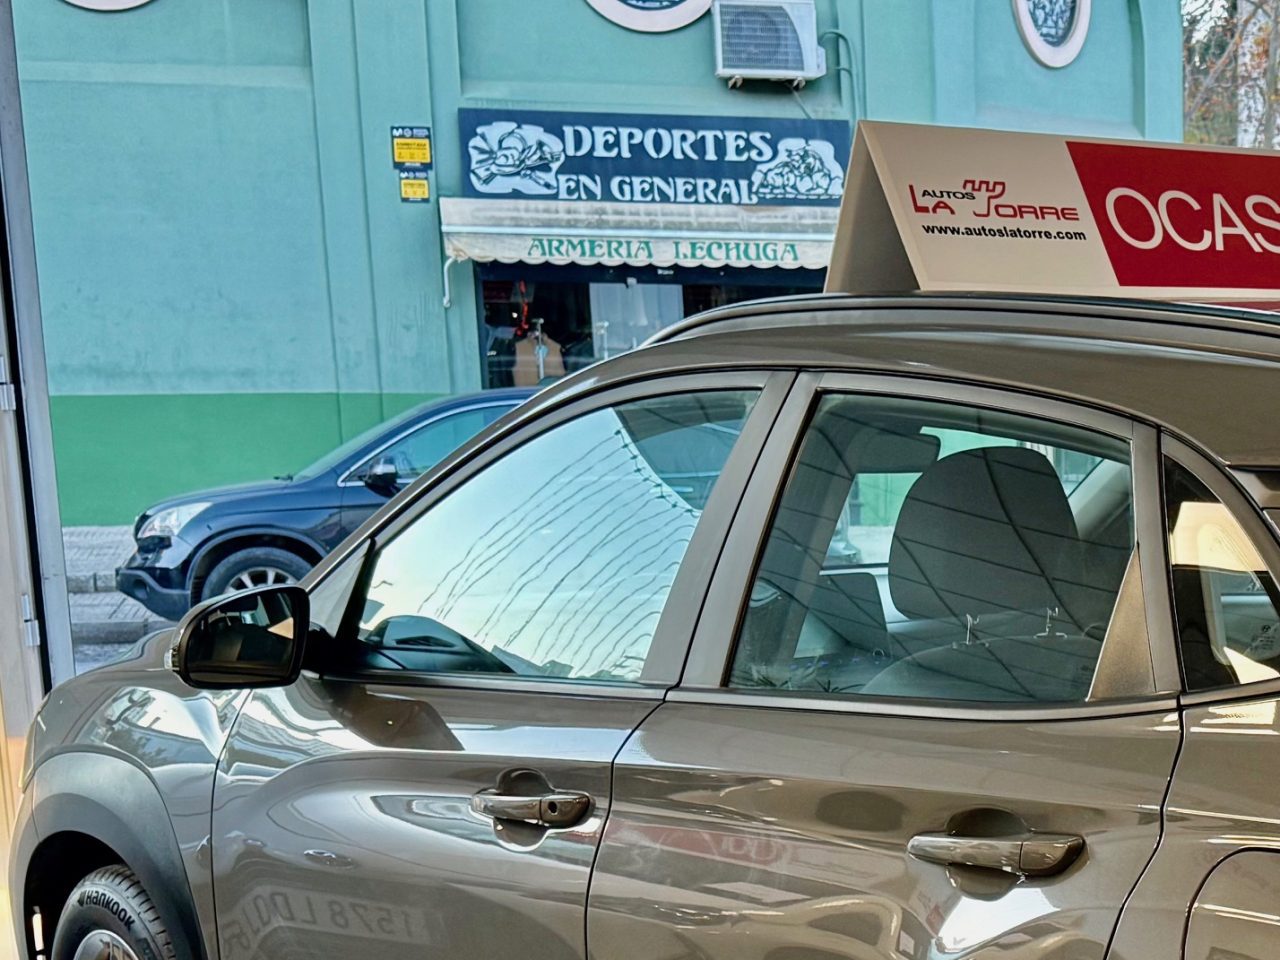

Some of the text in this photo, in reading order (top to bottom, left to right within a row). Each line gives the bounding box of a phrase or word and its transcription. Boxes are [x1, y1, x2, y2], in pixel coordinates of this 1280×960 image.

[562, 124, 775, 163] DEPORTES
[557, 173, 758, 205] EN GENERAL
[909, 179, 1081, 222] LA TORRE
[921, 189, 976, 201] AUTOS
[922, 224, 1087, 241] www.autoslatorre.com
[527, 237, 800, 262] ARMERIA LECHUGA
